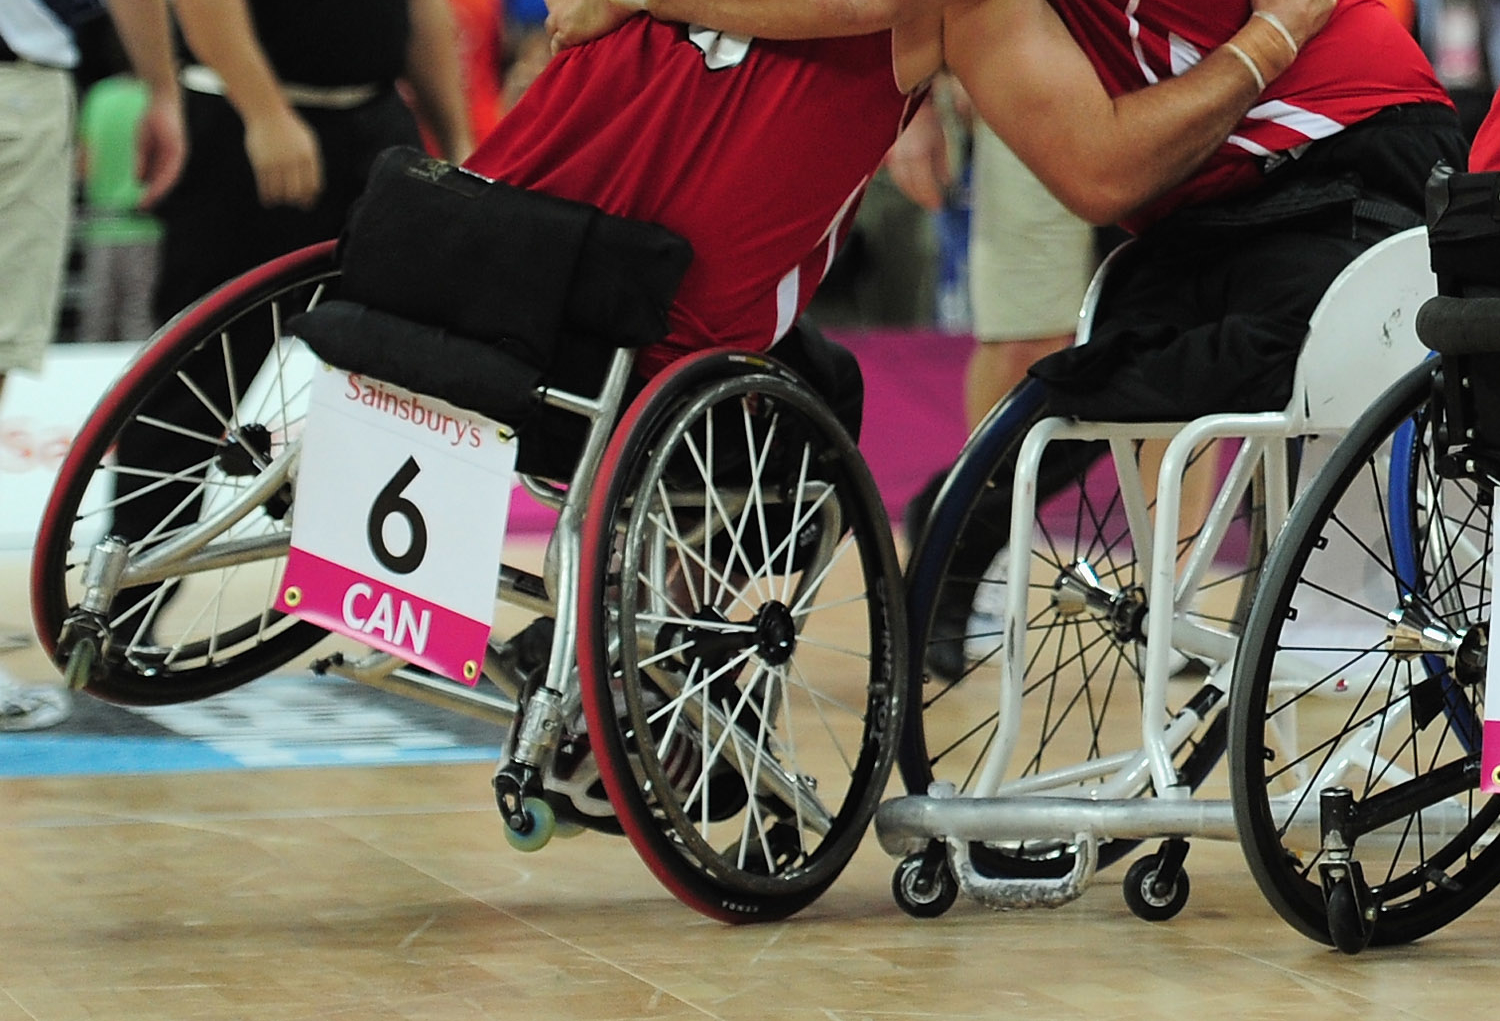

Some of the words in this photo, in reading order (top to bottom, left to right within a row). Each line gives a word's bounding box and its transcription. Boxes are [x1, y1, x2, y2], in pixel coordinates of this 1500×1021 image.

[345, 373, 481, 448] Sainsbury's
[367, 455, 427, 574] 6
[342, 582, 431, 655] CAN
